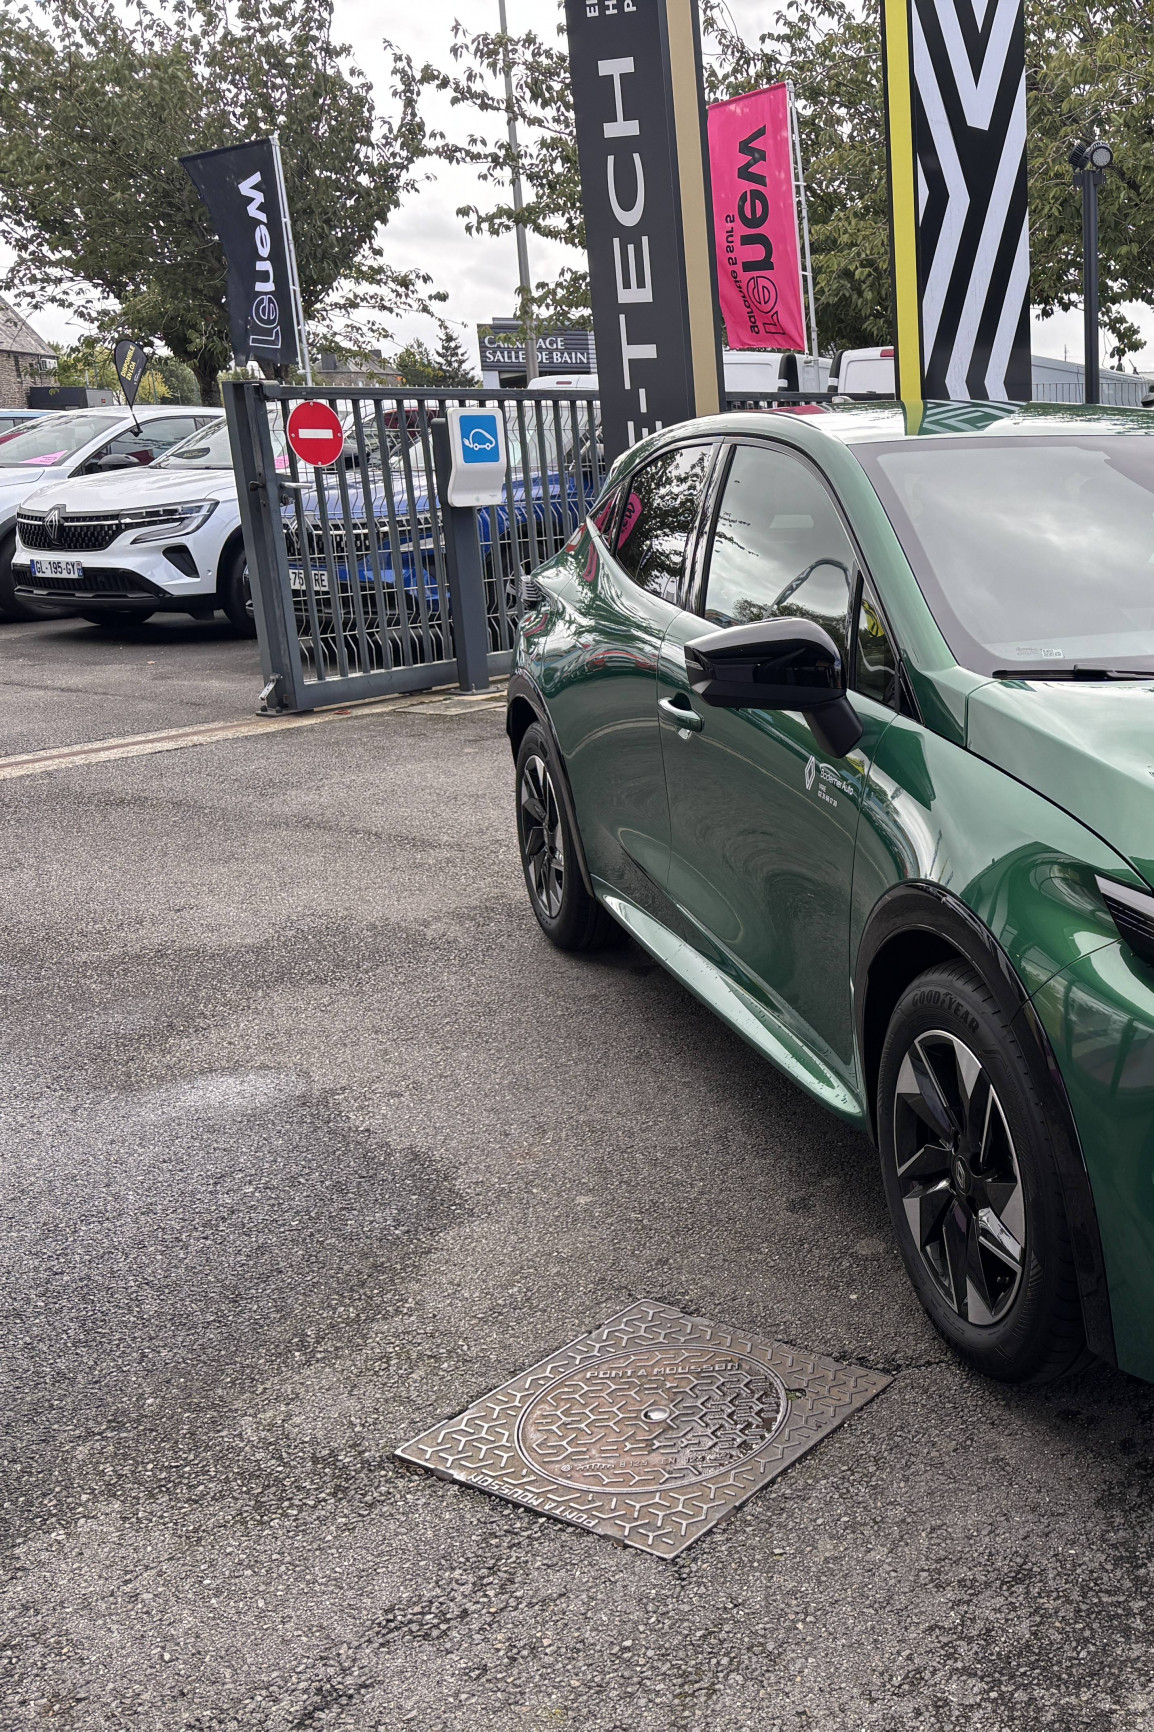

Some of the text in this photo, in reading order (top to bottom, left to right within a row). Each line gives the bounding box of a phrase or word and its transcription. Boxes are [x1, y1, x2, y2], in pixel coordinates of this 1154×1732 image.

[485, 350, 527, 363] SALLE
[553, 351, 588, 364] BAIN
[35, 560, 76, 576] GL-195-GY
[911, 989, 980, 1034] GOODYEAR
[652, 1361, 741, 1375] MOUSSON
[466, 1472, 545, 1505] MOUSSON
